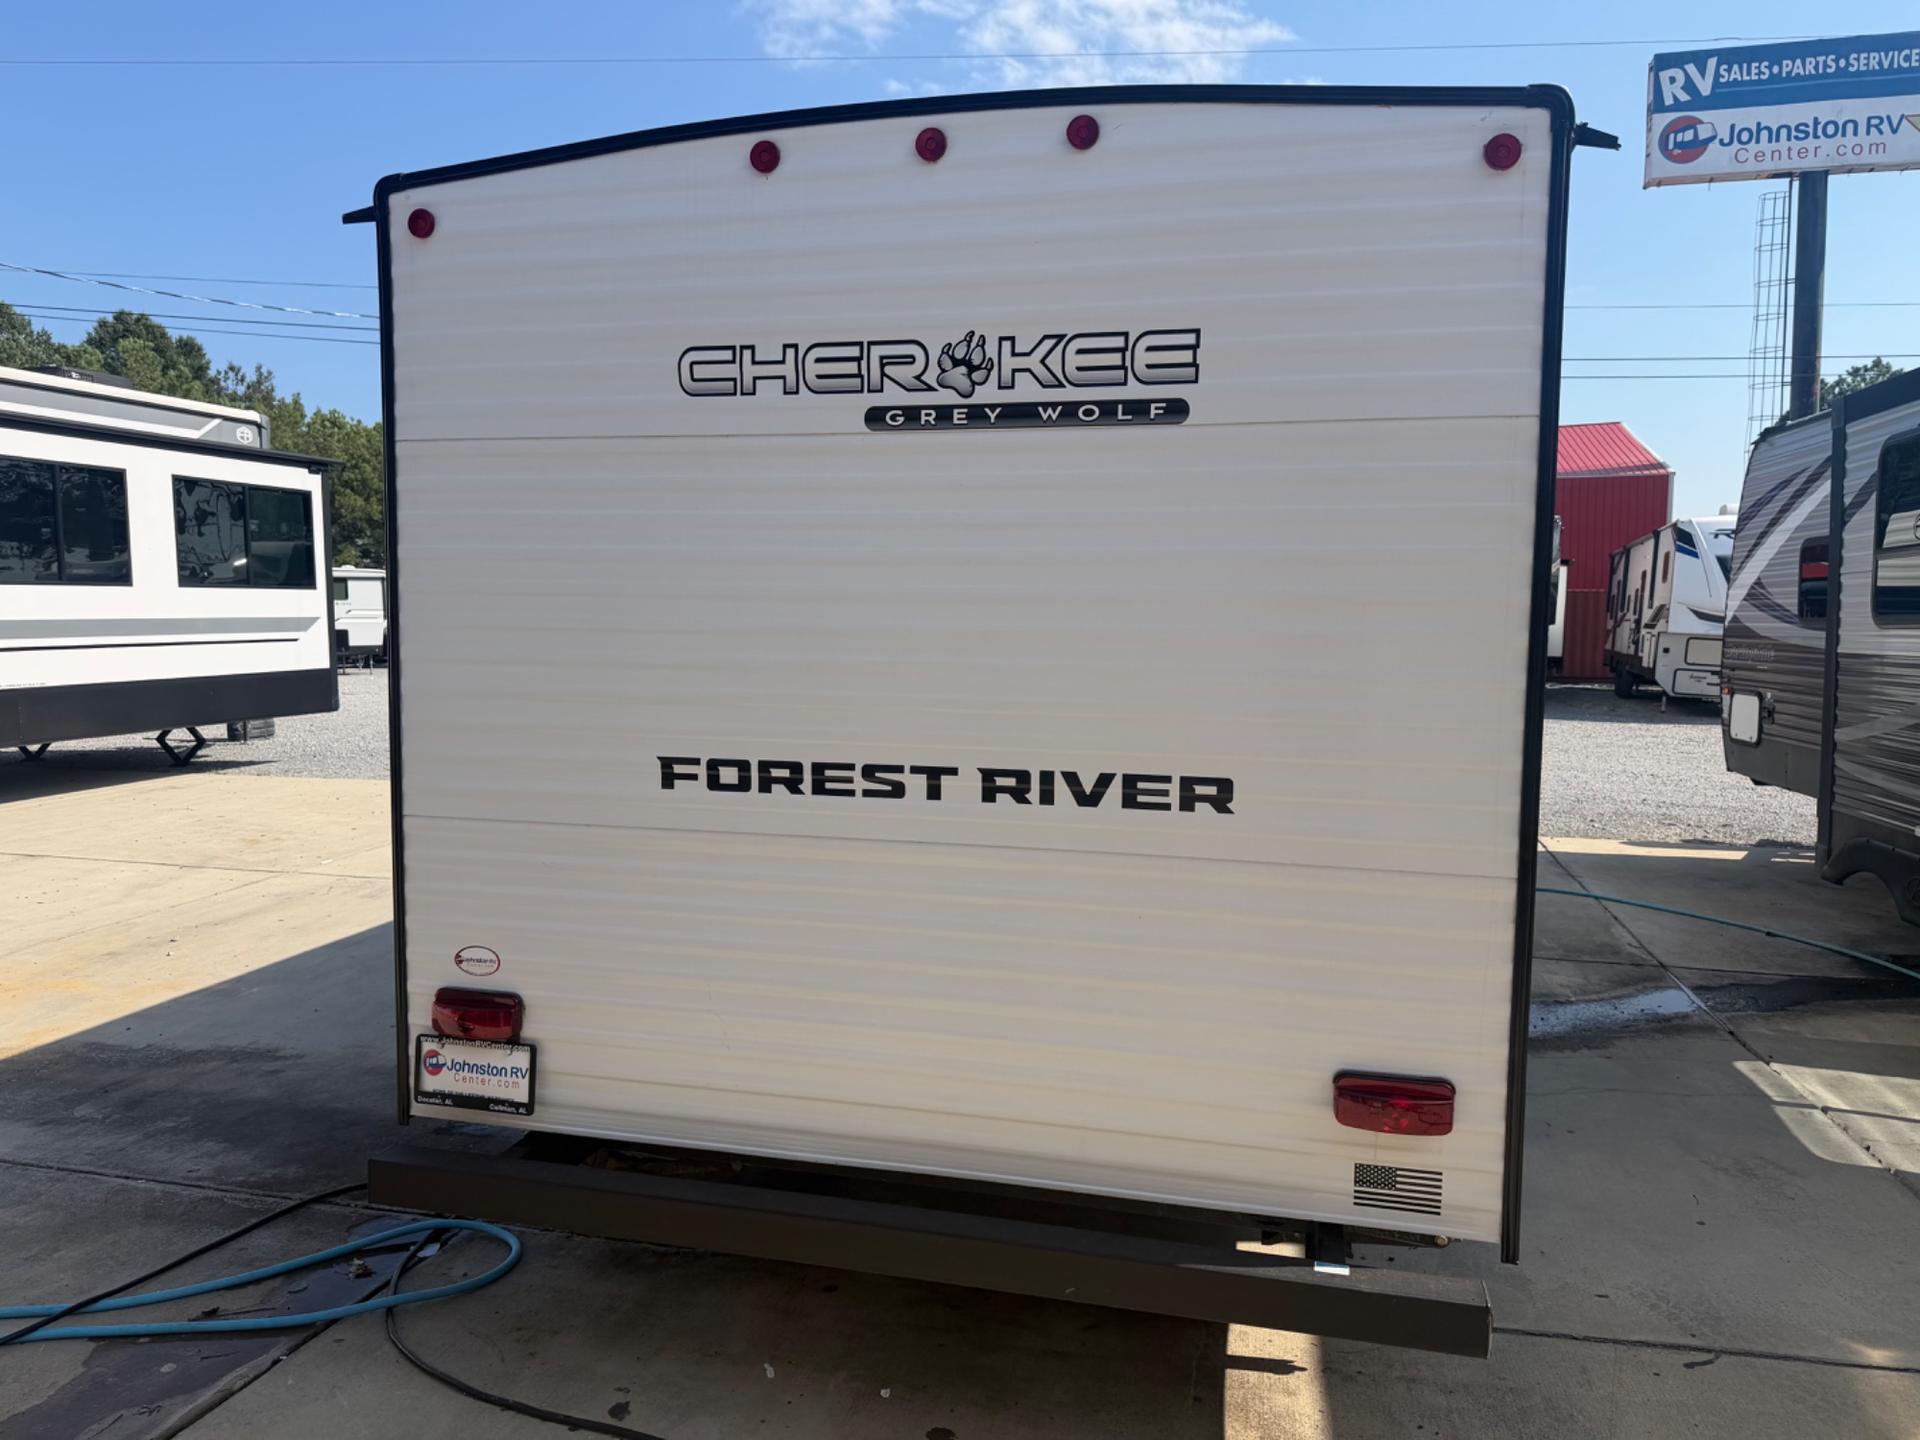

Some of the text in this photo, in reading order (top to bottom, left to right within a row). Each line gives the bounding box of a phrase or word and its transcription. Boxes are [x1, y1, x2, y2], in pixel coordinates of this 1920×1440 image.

[1659, 56, 1718, 106] RV
[1719, 61, 1770, 83] SALES
[1781, 54, 1836, 78] PARTS
[1718, 114, 1905, 147] Johnston RV
[1734, 141, 1887, 164] Center.com
[885, 402, 1168, 427] GREY WOLF
[656, 756, 1235, 815] FOREST RIVER
[447, 1058, 529, 1079] Johnston RV
[453, 1073, 520, 1089] Center.com
